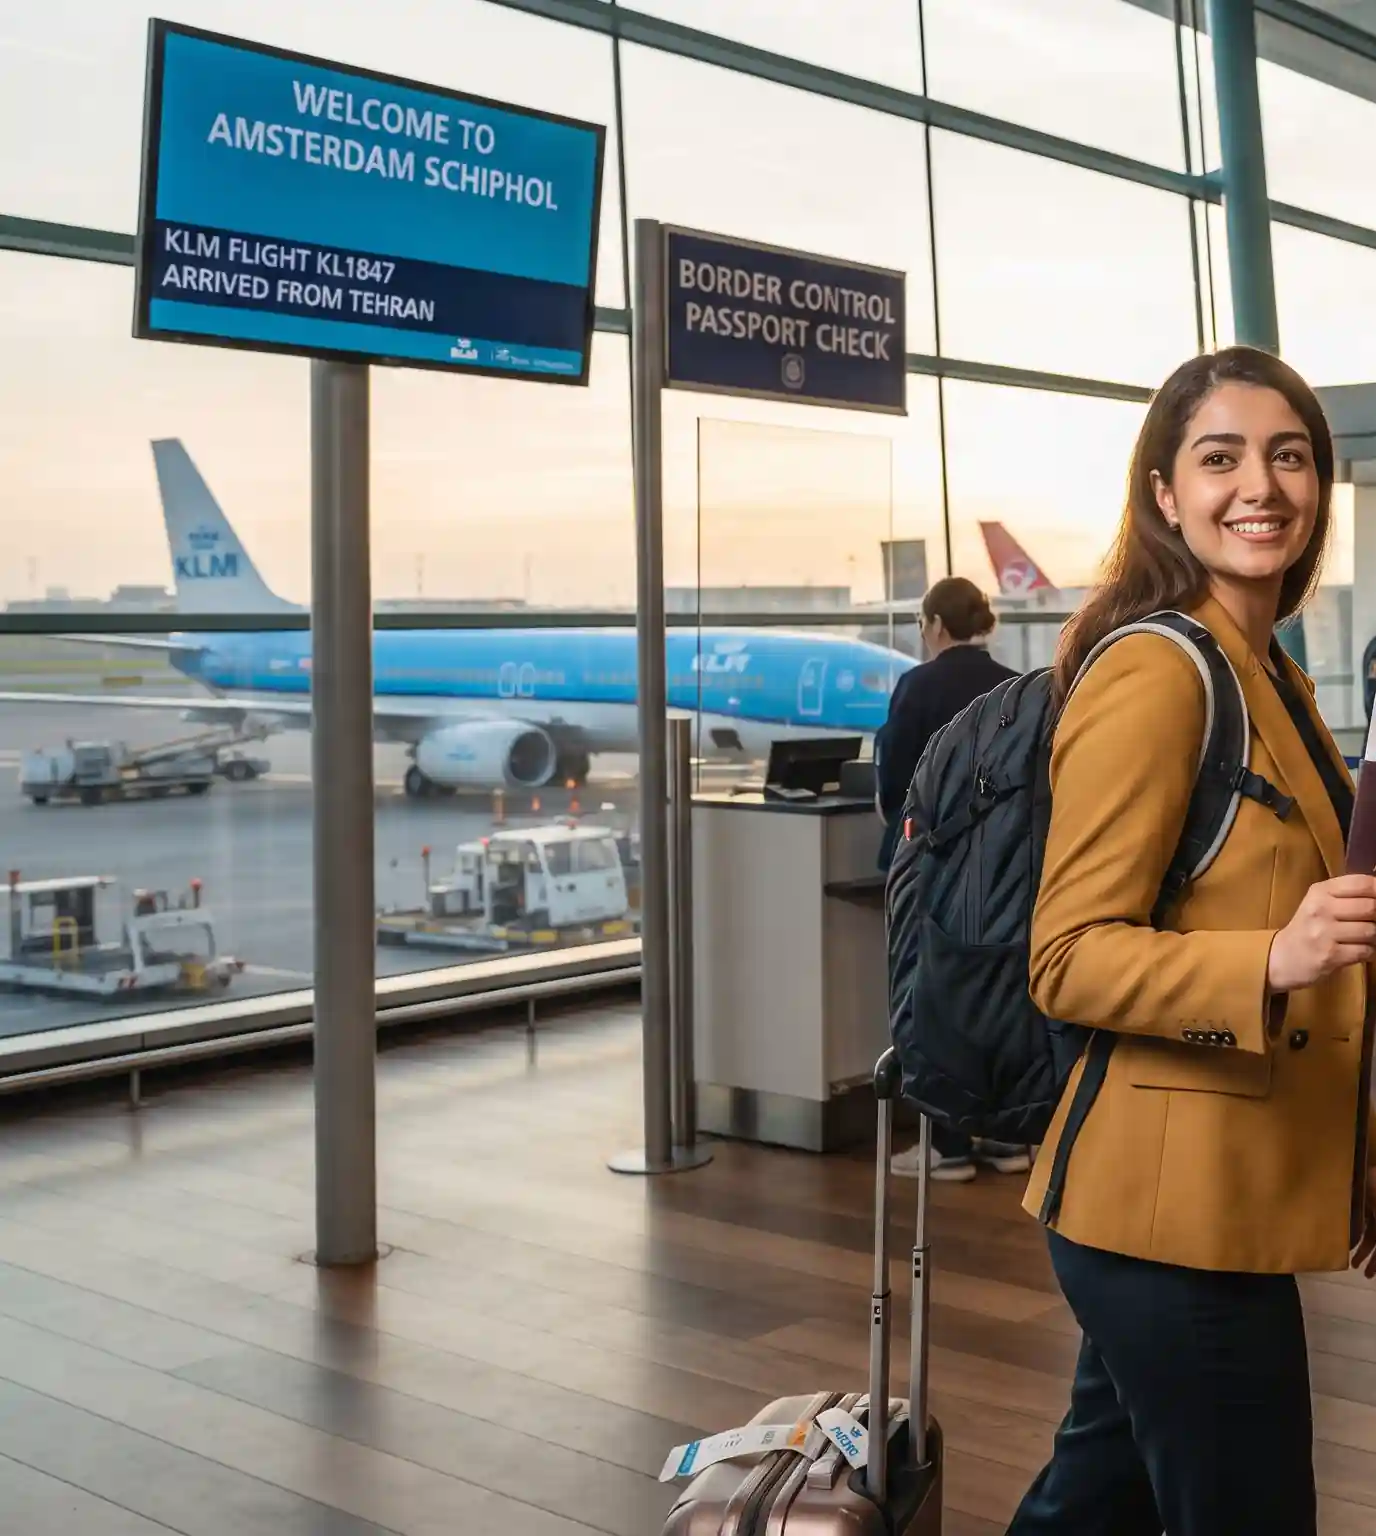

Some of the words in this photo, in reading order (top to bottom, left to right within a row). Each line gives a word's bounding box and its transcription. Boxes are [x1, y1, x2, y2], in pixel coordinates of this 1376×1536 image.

[292, 80, 450, 145] WELCOME
[458, 119, 495, 155] TO
[207, 113, 416, 182] AMSTERDAM
[424, 156, 558, 211] SCHIPHOL
[164, 227, 221, 261] KLM
[229, 238, 311, 272] FLIGHT
[316, 247, 396, 284] KL1847
[161, 264, 270, 300] ARRIVED
[277, 280, 343, 312] FROM
[349, 289, 436, 322] TEHRAN
[679, 258, 783, 305] BORDER
[789, 279, 896, 324] CONTROL
[686, 301, 810, 348] PASSPORT
[816, 323, 891, 361] CHECK
[176, 553, 238, 577] KLM
